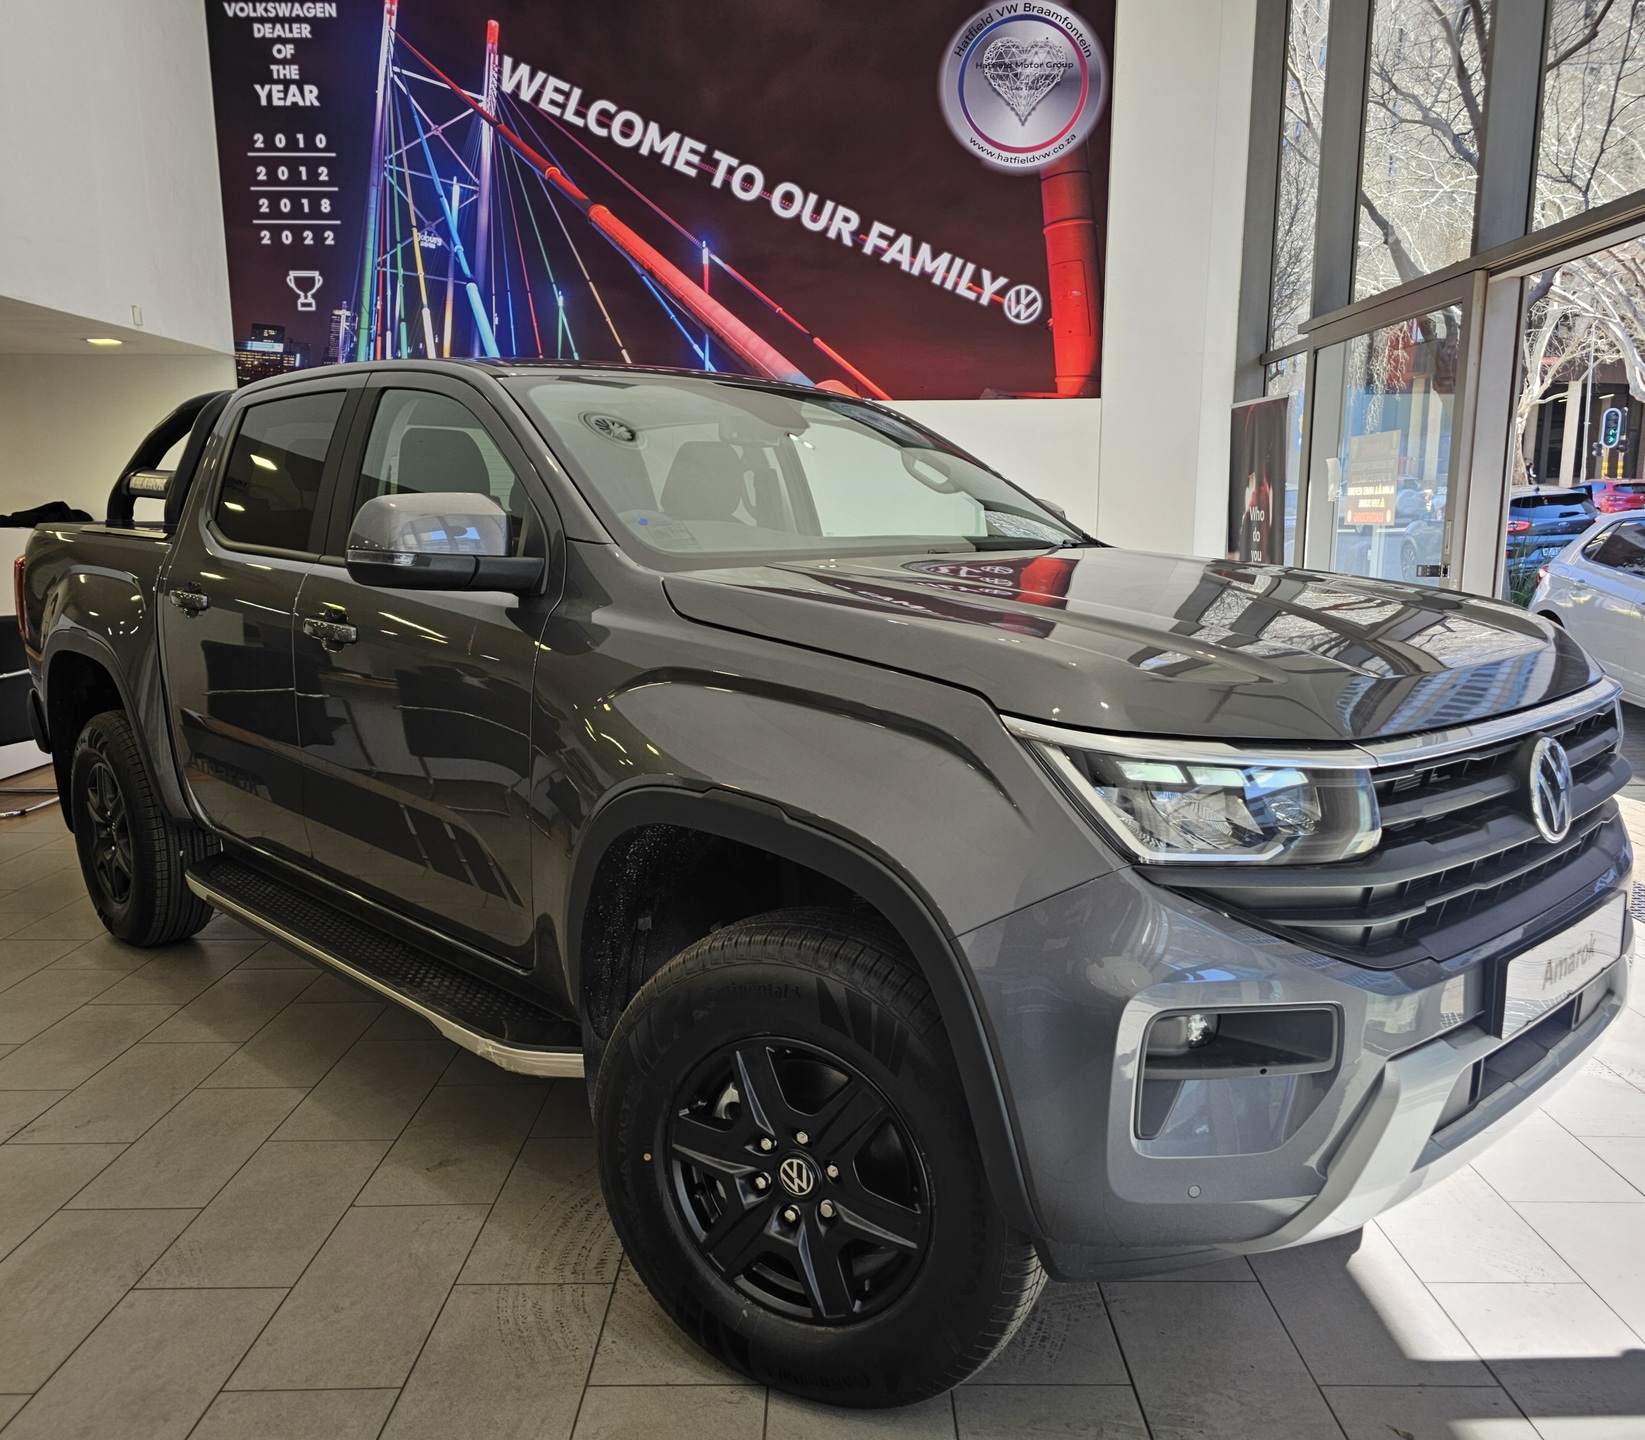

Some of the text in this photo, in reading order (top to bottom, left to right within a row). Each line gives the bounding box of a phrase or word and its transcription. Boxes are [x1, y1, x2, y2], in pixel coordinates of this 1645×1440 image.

[224, 2, 337, 18] VOLKSWAGEN
[253, 23, 312, 38] DEALER
[954, 2, 1093, 59] Hatfield VW Braamfontein
[272, 44, 295, 59] OF
[270, 65, 299, 79] THE
[1046, 61, 1074, 70] Group
[254, 84, 320, 107] YEAR
[253, 133, 327, 148] 2010
[969, 133, 1077, 165] www.hatfieldvw.co.za
[256, 166, 329, 181] 2012
[501, 54, 706, 178] WELCOME
[711, 150, 764, 201] TO
[770, 181, 860, 247] OUR
[862, 220, 1009, 307] FAMILY
[258, 198, 331, 213] 2018
[260, 230, 335, 245] 2022
[1250, 506, 1264, 522] Who
[1252, 528, 1261, 542] do
[1250, 549, 1262, 563] you
[1541, 931, 1597, 991] Amarok
